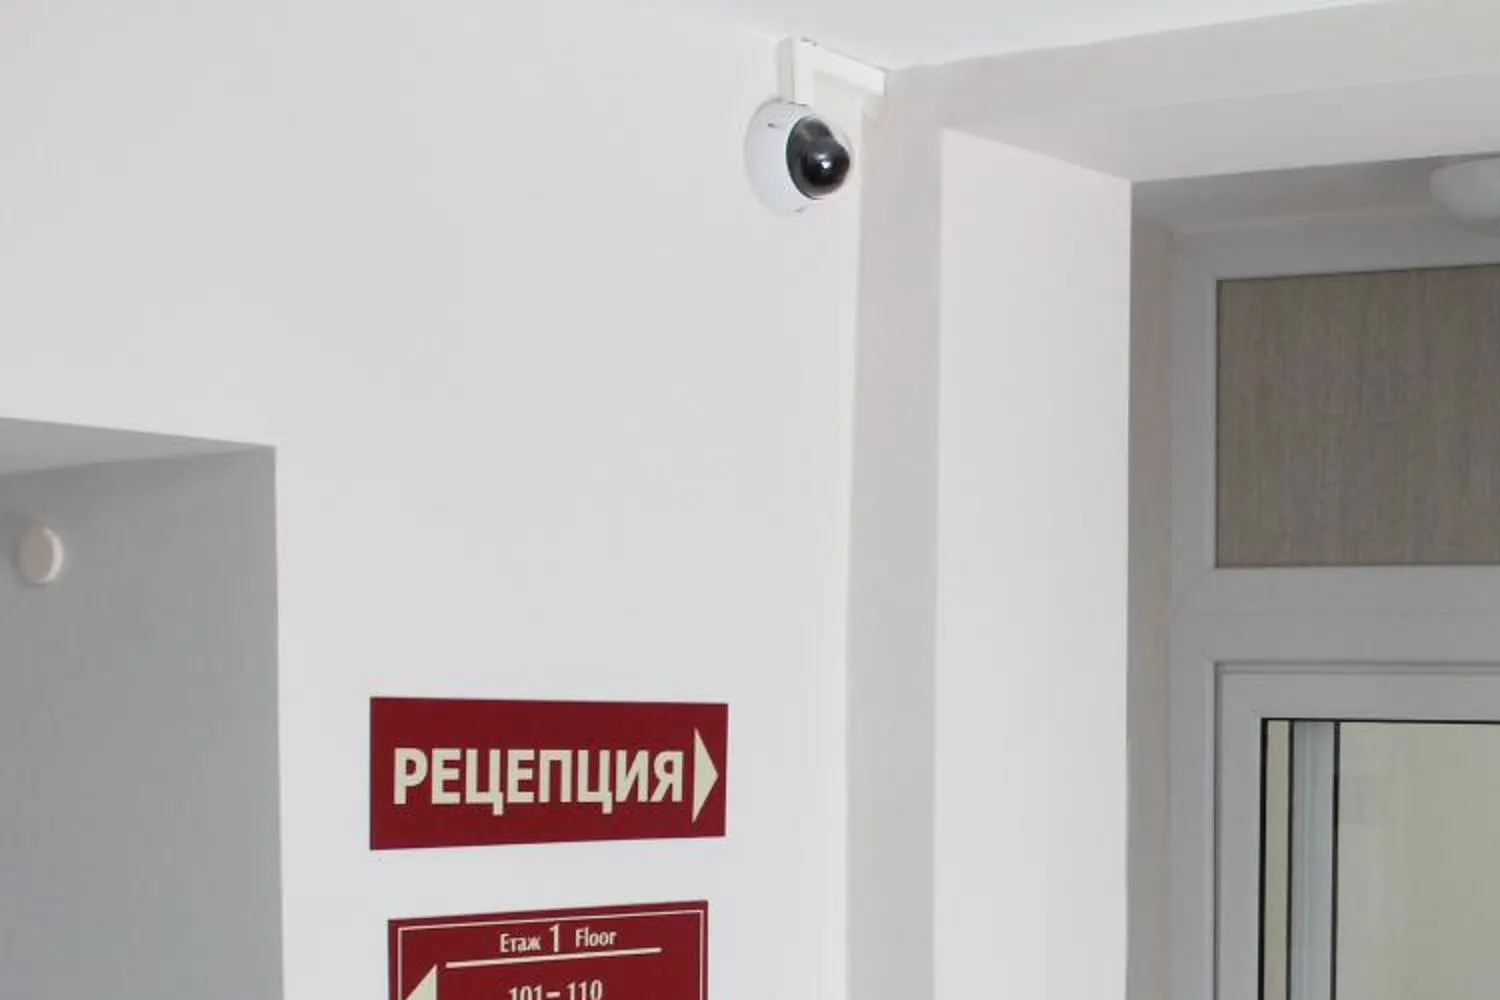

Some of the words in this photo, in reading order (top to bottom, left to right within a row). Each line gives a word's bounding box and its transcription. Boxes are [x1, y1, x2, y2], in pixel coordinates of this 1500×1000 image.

[393, 747, 684, 816] РЕЦЕПЦИЯ
[500, 932, 541, 953] Етаж
[549, 923, 560, 953] 1
[575, 926, 617, 948] Floor
